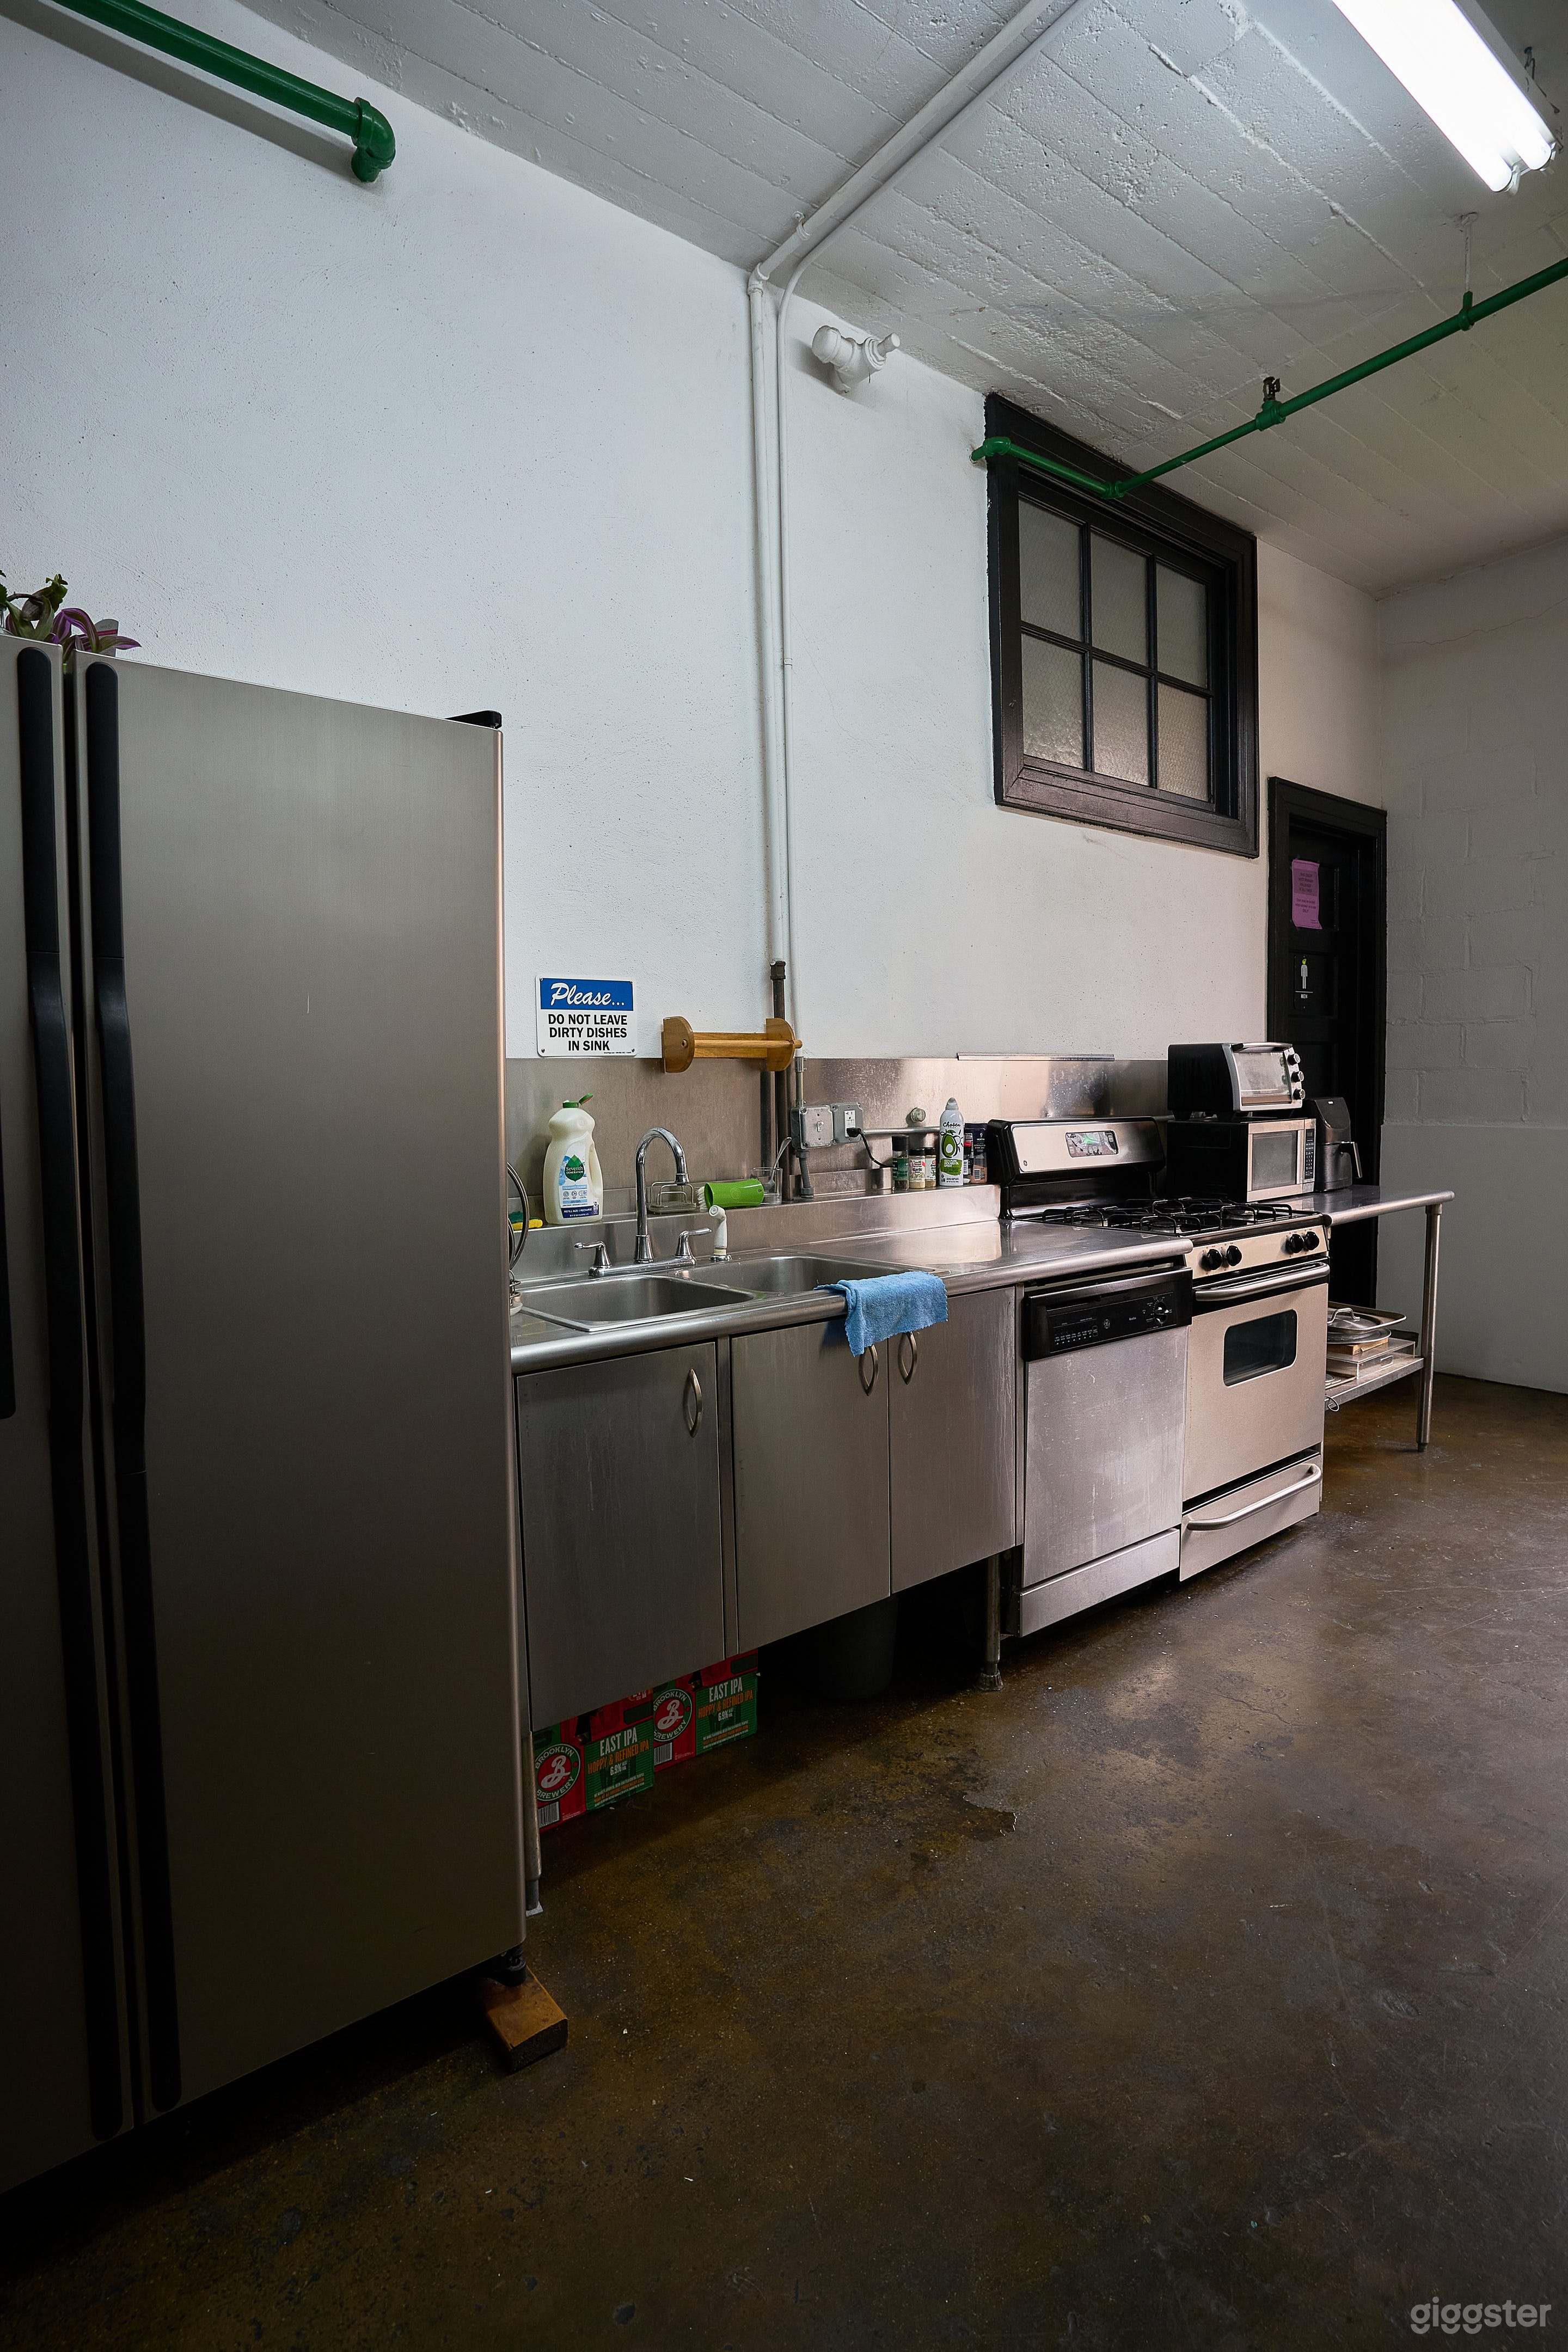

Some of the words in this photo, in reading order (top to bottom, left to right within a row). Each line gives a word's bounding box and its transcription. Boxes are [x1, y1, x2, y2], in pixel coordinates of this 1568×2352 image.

[550, 982, 624, 1006] Please...
[548, 1014, 565, 1025] DO
[568, 1014, 590, 1025] NOT
[594, 1014, 628, 1025] LEAVE
[549, 1027, 584, 1038] DIRTY
[587, 1027, 627, 1038] DISHES
[568, 1040, 579, 1051] IN
[583, 1040, 610, 1051] SINK
[653, 1691, 687, 1711] BROOKLYN
[709, 1682, 728, 1702] EAST
[731, 1677, 743, 1695] IPA
[698, 1702, 716, 1719] HOPPY
[717, 1701, 721, 1712] &
[722, 1693, 744, 1710] REFINED
[745, 1689, 754, 1701] IPA
[718, 1710, 728, 1722] 6.9%
[600, 1733, 621, 1756] EAST
[623, 1726, 638, 1747] IPA
[535, 1746, 574, 1769] BROOKLYN
[587, 1756, 608, 1775] HOPPY
[609, 1755, 614, 1766] &
[615, 1743, 639, 1763] REFINED
[640, 1739, 650, 1753] IPA
[610, 1764, 622, 1776] 6.9%
[536, 1776, 574, 1799] BREWERY
